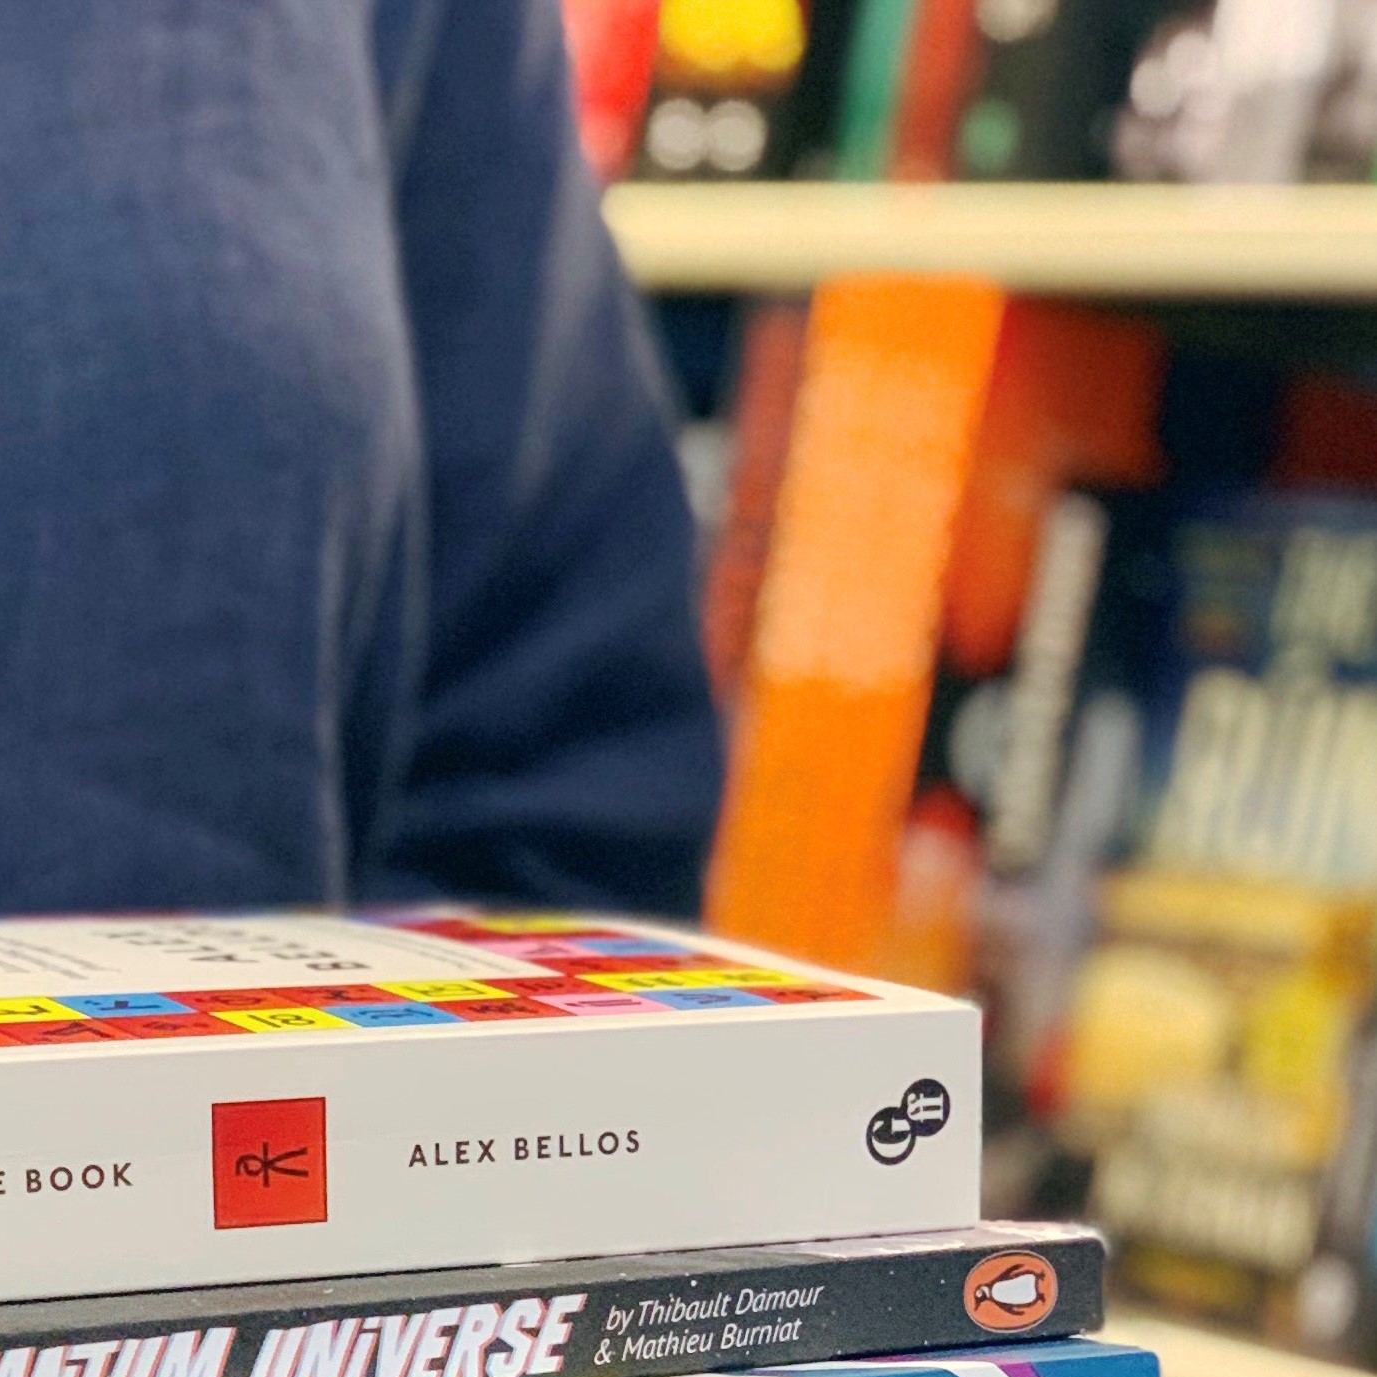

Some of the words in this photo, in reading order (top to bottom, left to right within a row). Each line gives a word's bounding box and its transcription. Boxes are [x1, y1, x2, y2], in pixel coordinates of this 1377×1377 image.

[408, 1139, 496, 1168] ALEX
[513, 1129, 642, 1160] BELLOS
[26, 1162, 135, 1194] BOOK
[606, 1306, 635, 1334] by
[638, 1289, 731, 1326] Thibault
[735, 1284, 825, 1315] Damour
[594, 1338, 615, 1366] &
[621, 1326, 714, 1362] Mathieu
[719, 1317, 803, 1351] Burniat
